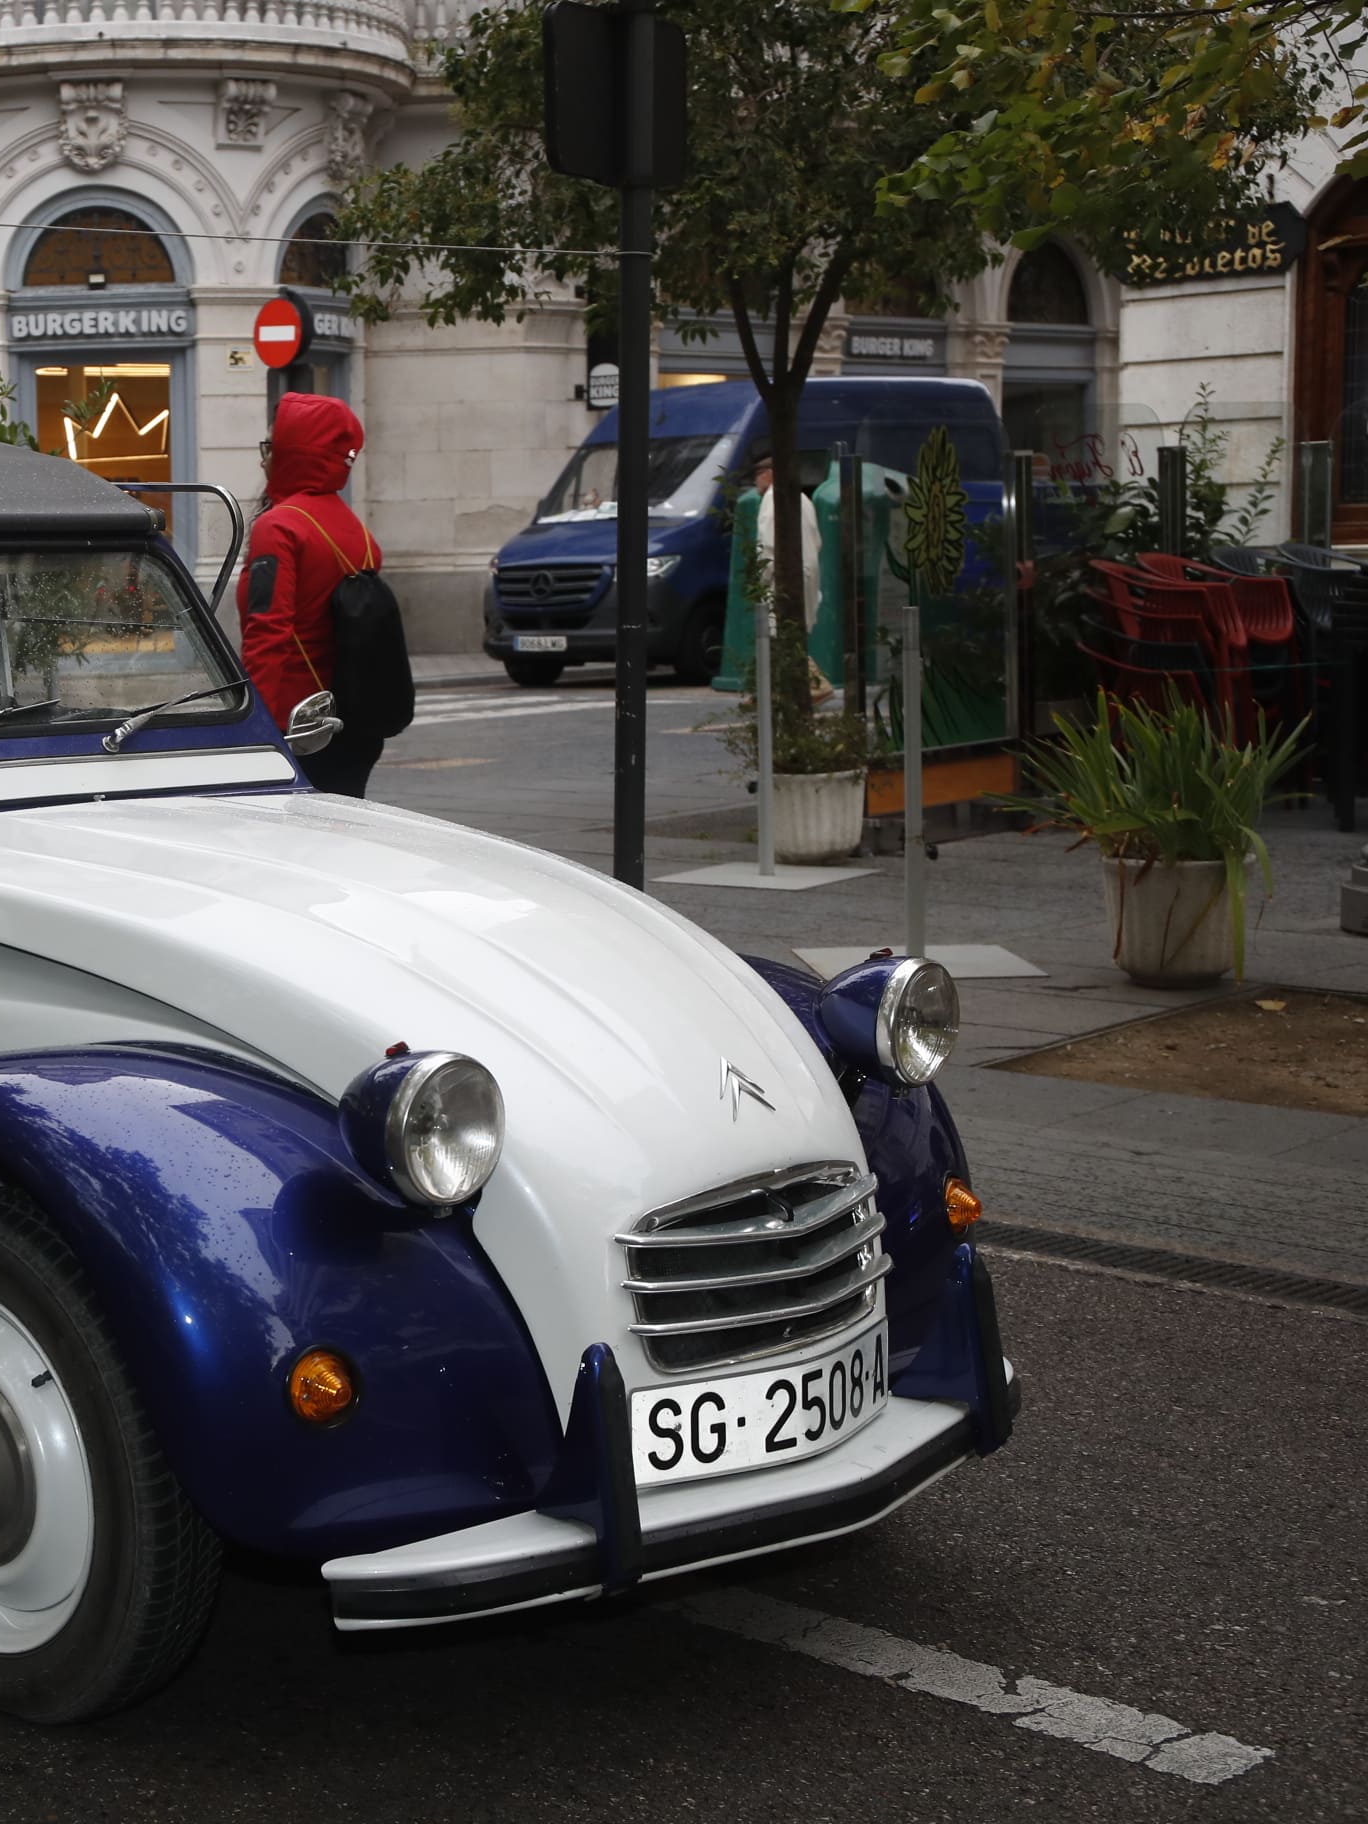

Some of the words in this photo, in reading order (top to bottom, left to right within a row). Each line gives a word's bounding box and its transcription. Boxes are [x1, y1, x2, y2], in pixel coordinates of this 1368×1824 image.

[11, 312, 116, 338] BURGER
[118, 309, 188, 334] KING
[852, 336, 901, 356] BURGER
[902, 339, 934, 357] KING
